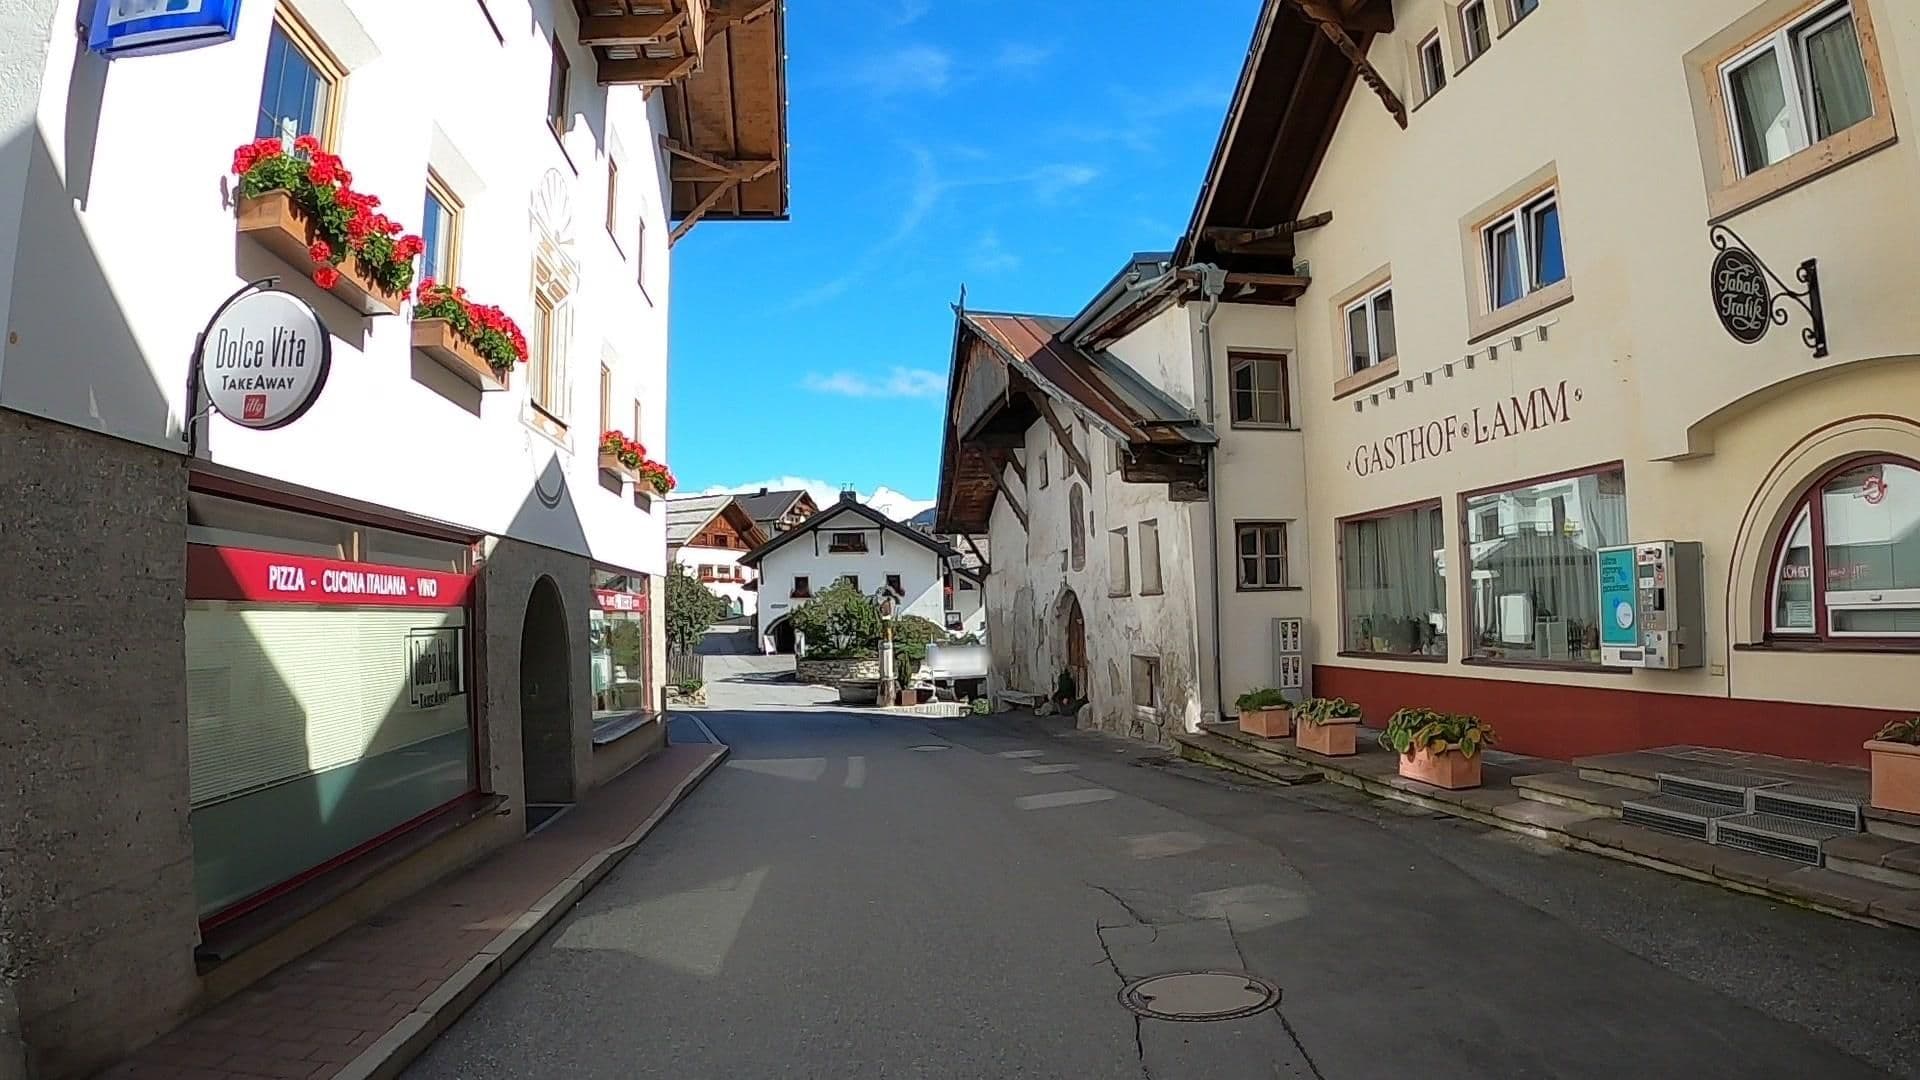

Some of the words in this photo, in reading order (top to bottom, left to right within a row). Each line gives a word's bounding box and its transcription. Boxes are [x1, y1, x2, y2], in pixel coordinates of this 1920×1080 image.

[1719, 269, 1764, 297] Tabak
[1721, 293, 1765, 325] Trafik
[216, 327, 264, 369] Dolce
[272, 326, 306, 367] Vita
[246, 399, 263, 416] illy
[1354, 415, 1457, 477] GASTHOF
[1472, 380, 1571, 444] LAMM
[269, 565, 305, 591] PIZZA
[322, 569, 364, 593] CUCINA
[366, 573, 407, 596] ITALIANA
[417, 578, 437, 597] VINO
